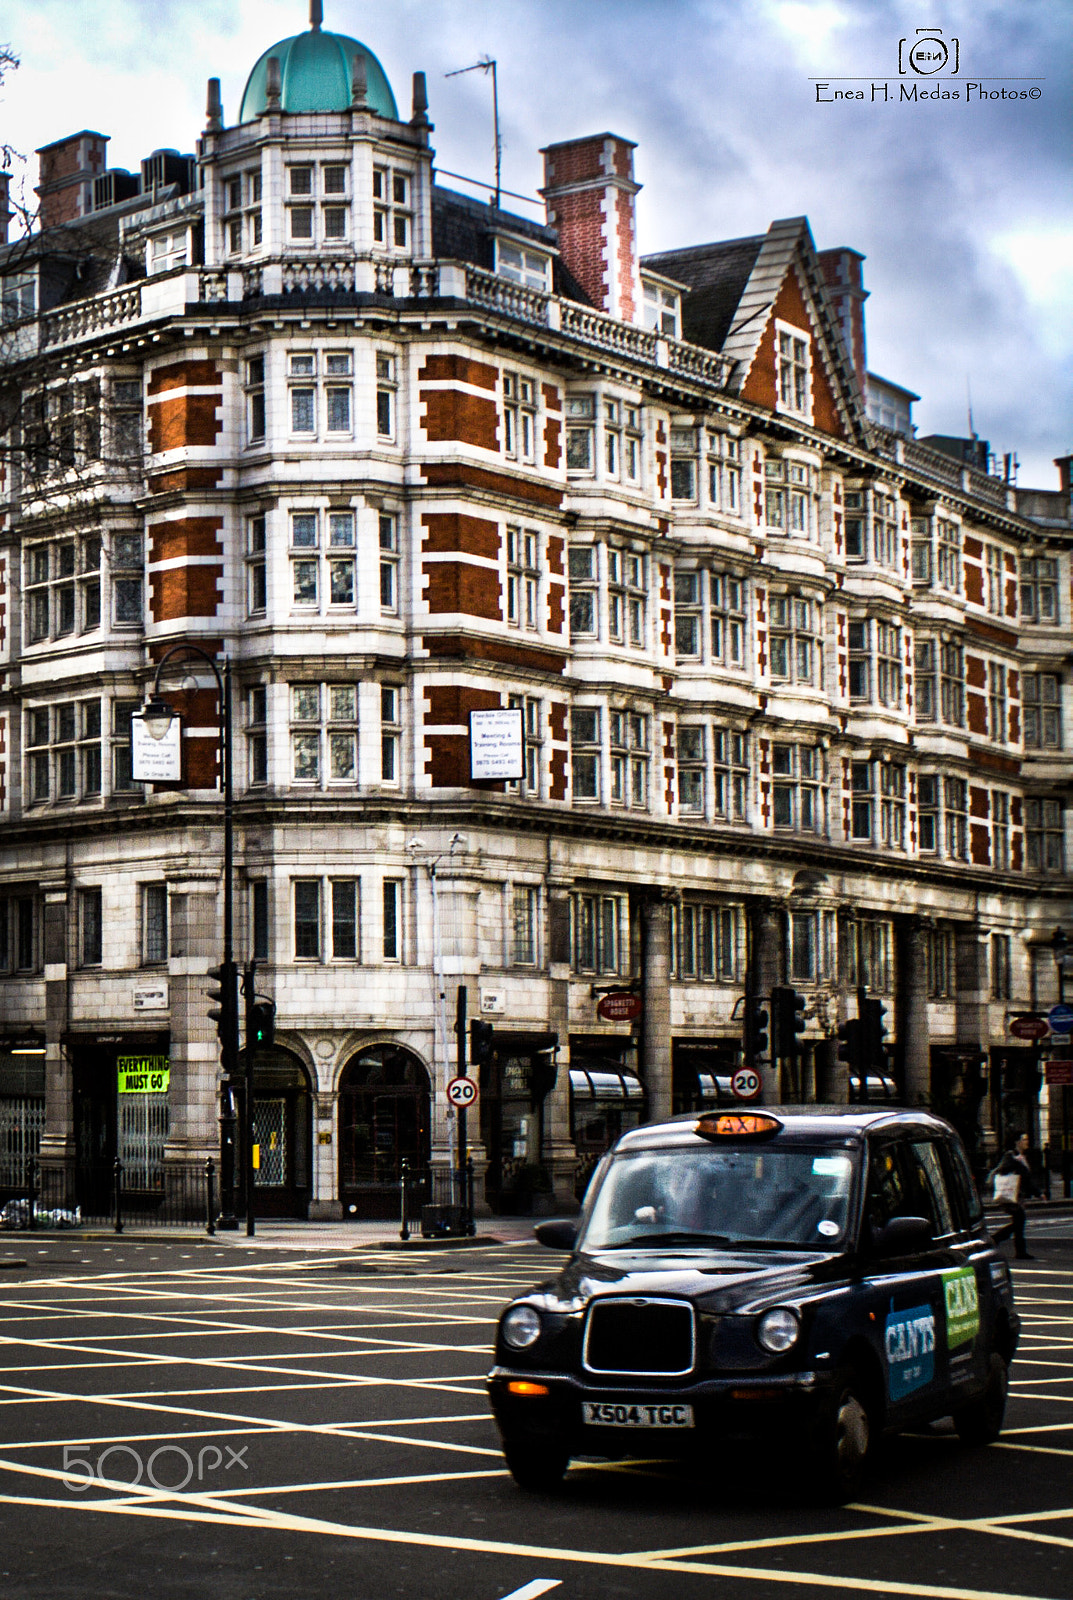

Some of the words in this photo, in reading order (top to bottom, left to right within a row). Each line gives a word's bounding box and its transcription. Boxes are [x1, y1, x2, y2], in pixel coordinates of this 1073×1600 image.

[118, 1057, 170, 1073] EVERYTHING
[126, 1074, 148, 1090] MUST
[150, 1073, 163, 1089] GO
[737, 1076, 757, 1090] 20
[452, 1085, 473, 1098] 20
[645, 1406, 687, 1424] TGC
